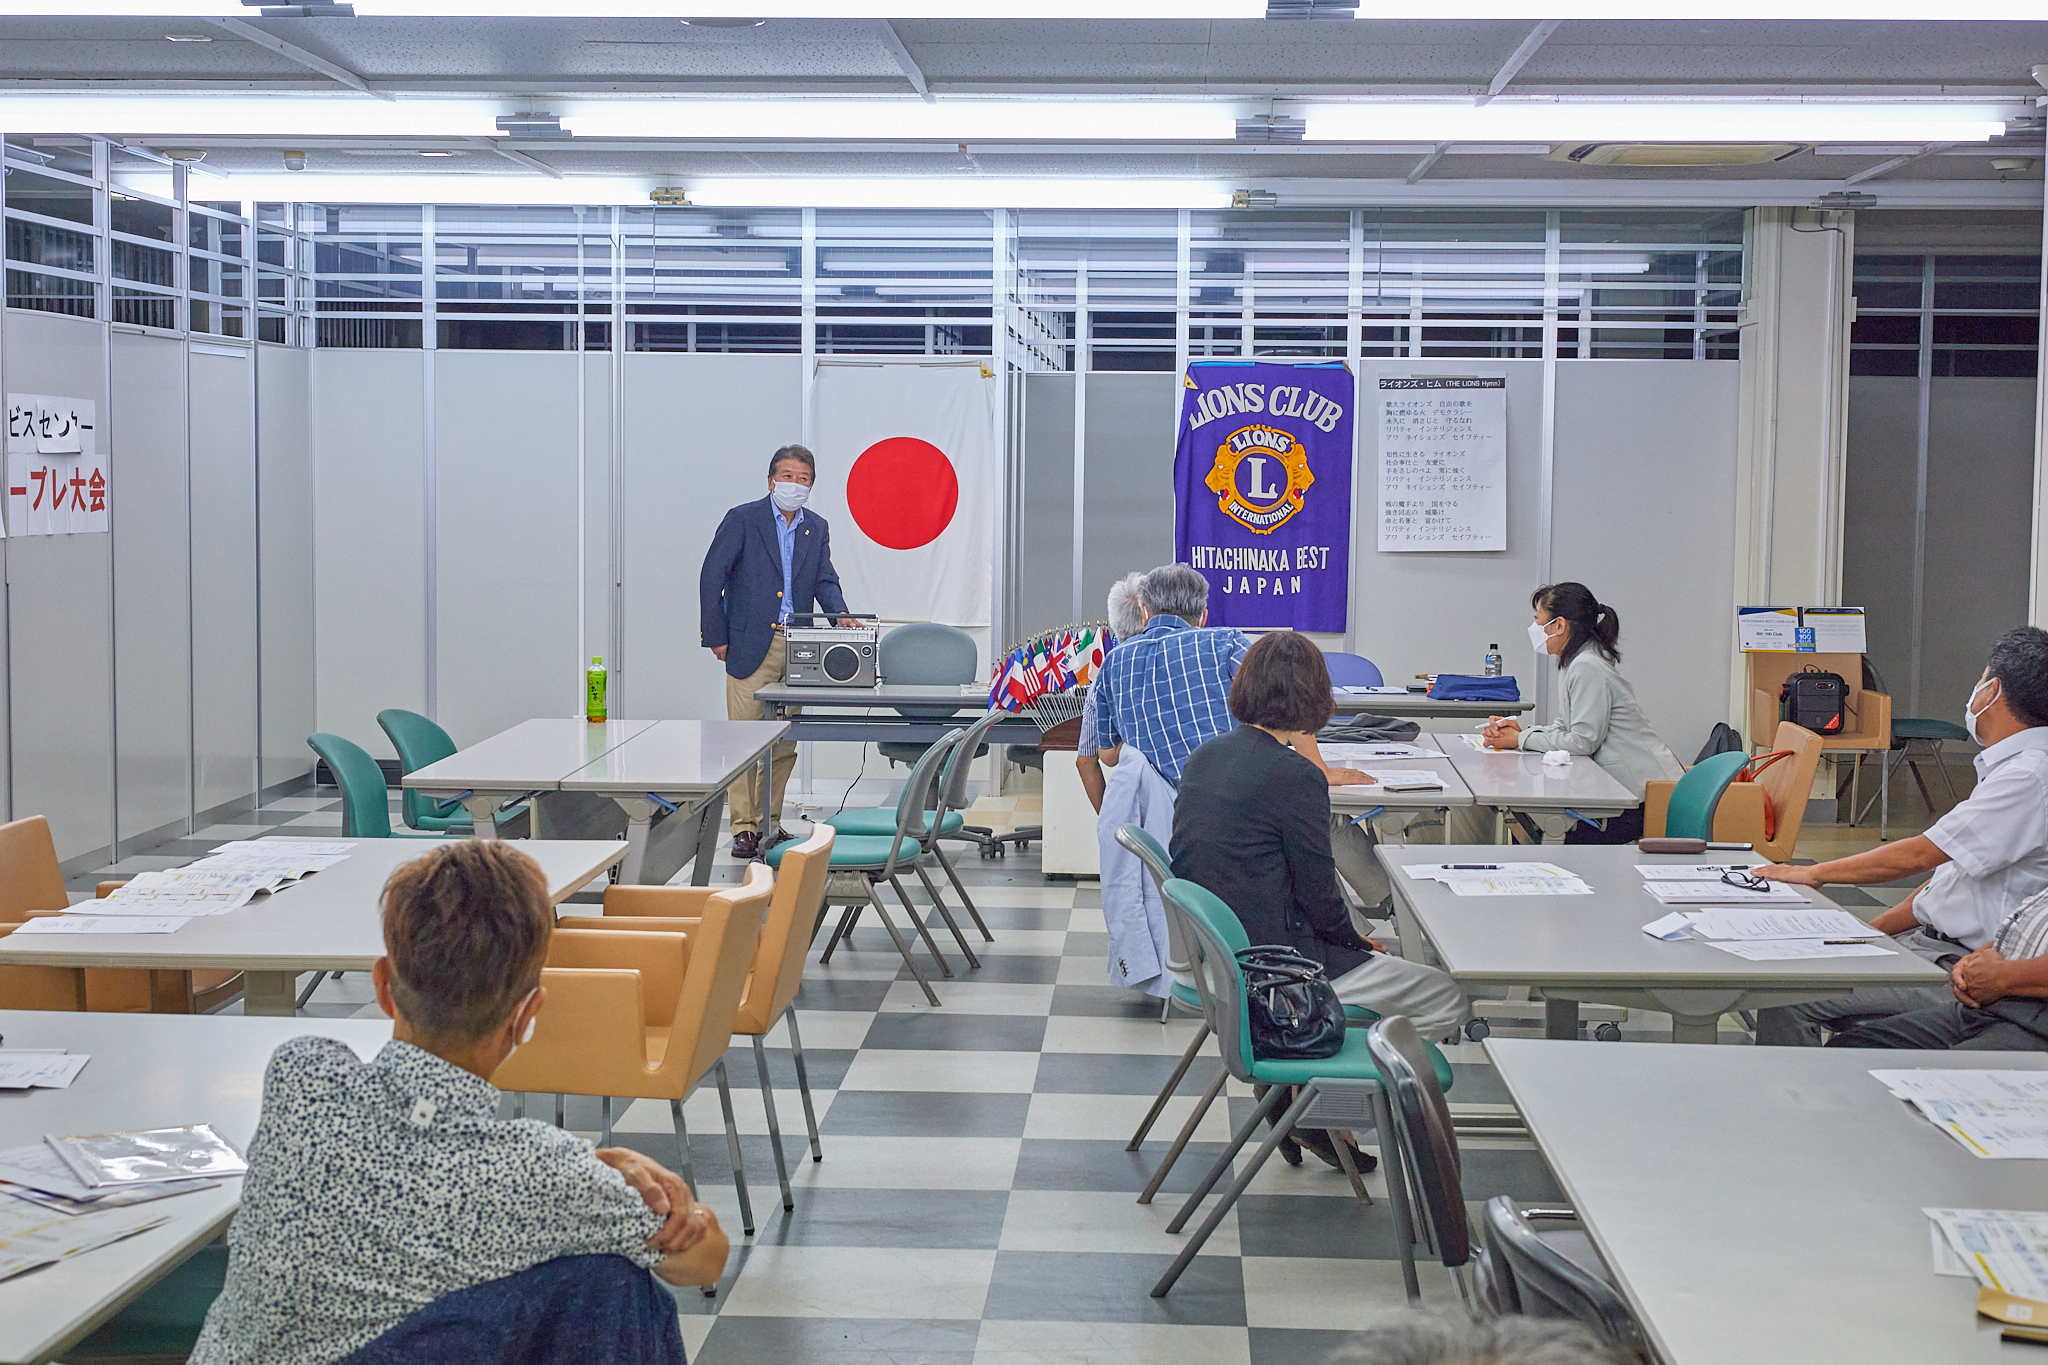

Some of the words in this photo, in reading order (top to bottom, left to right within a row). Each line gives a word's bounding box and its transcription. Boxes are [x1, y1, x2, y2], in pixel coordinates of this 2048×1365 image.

[1380, 380, 1442, 388] ライオンズ・ヒム
[1446, 380, 1460, 388] (THE
[1462, 380, 1480, 388] LIONS
[1482, 380, 1501, 388] Hymn)
[1189, 383, 1264, 430] LIONS
[1269, 386, 1343, 432] CLUB
[1232, 430, 1290, 452] LIONS
[10, 466, 105, 512] ープレ大会
[1248, 458, 1278, 498] L
[1229, 501, 1294, 524] INTERNATIONAL
[1192, 547, 1289, 571] HITACHINAKA
[1297, 546, 1329, 570] BEST
[1223, 576, 1300, 595] JAPAN
